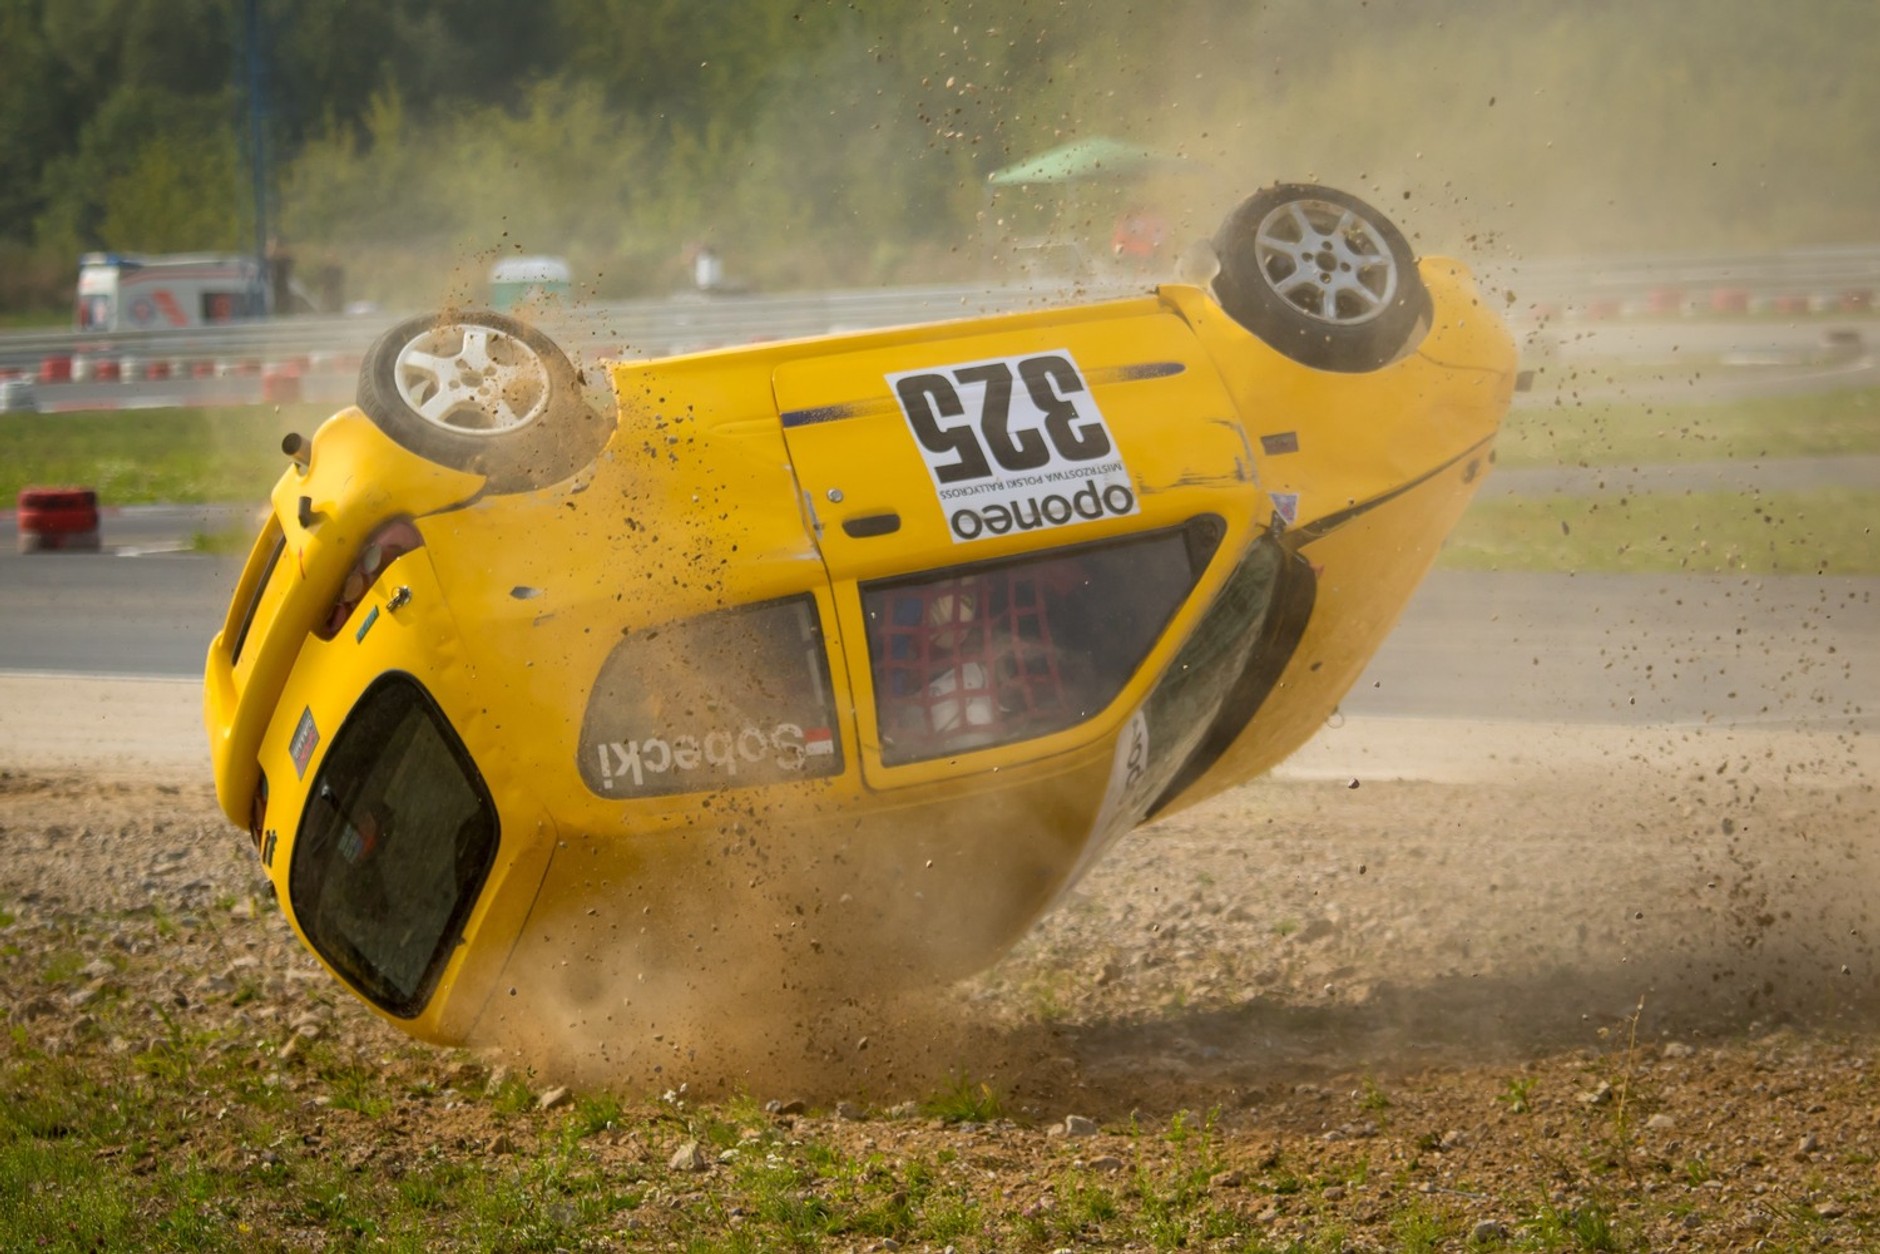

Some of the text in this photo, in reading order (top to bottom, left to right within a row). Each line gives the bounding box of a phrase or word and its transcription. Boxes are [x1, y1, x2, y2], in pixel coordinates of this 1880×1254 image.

[896, 355, 1111, 484] 325
[939, 462, 1123, 500] MISTRZOSTWA POLSKI RALLYCROSS
[951, 480, 1134, 540] oponeo
[598, 723, 806, 789] Sobecki
